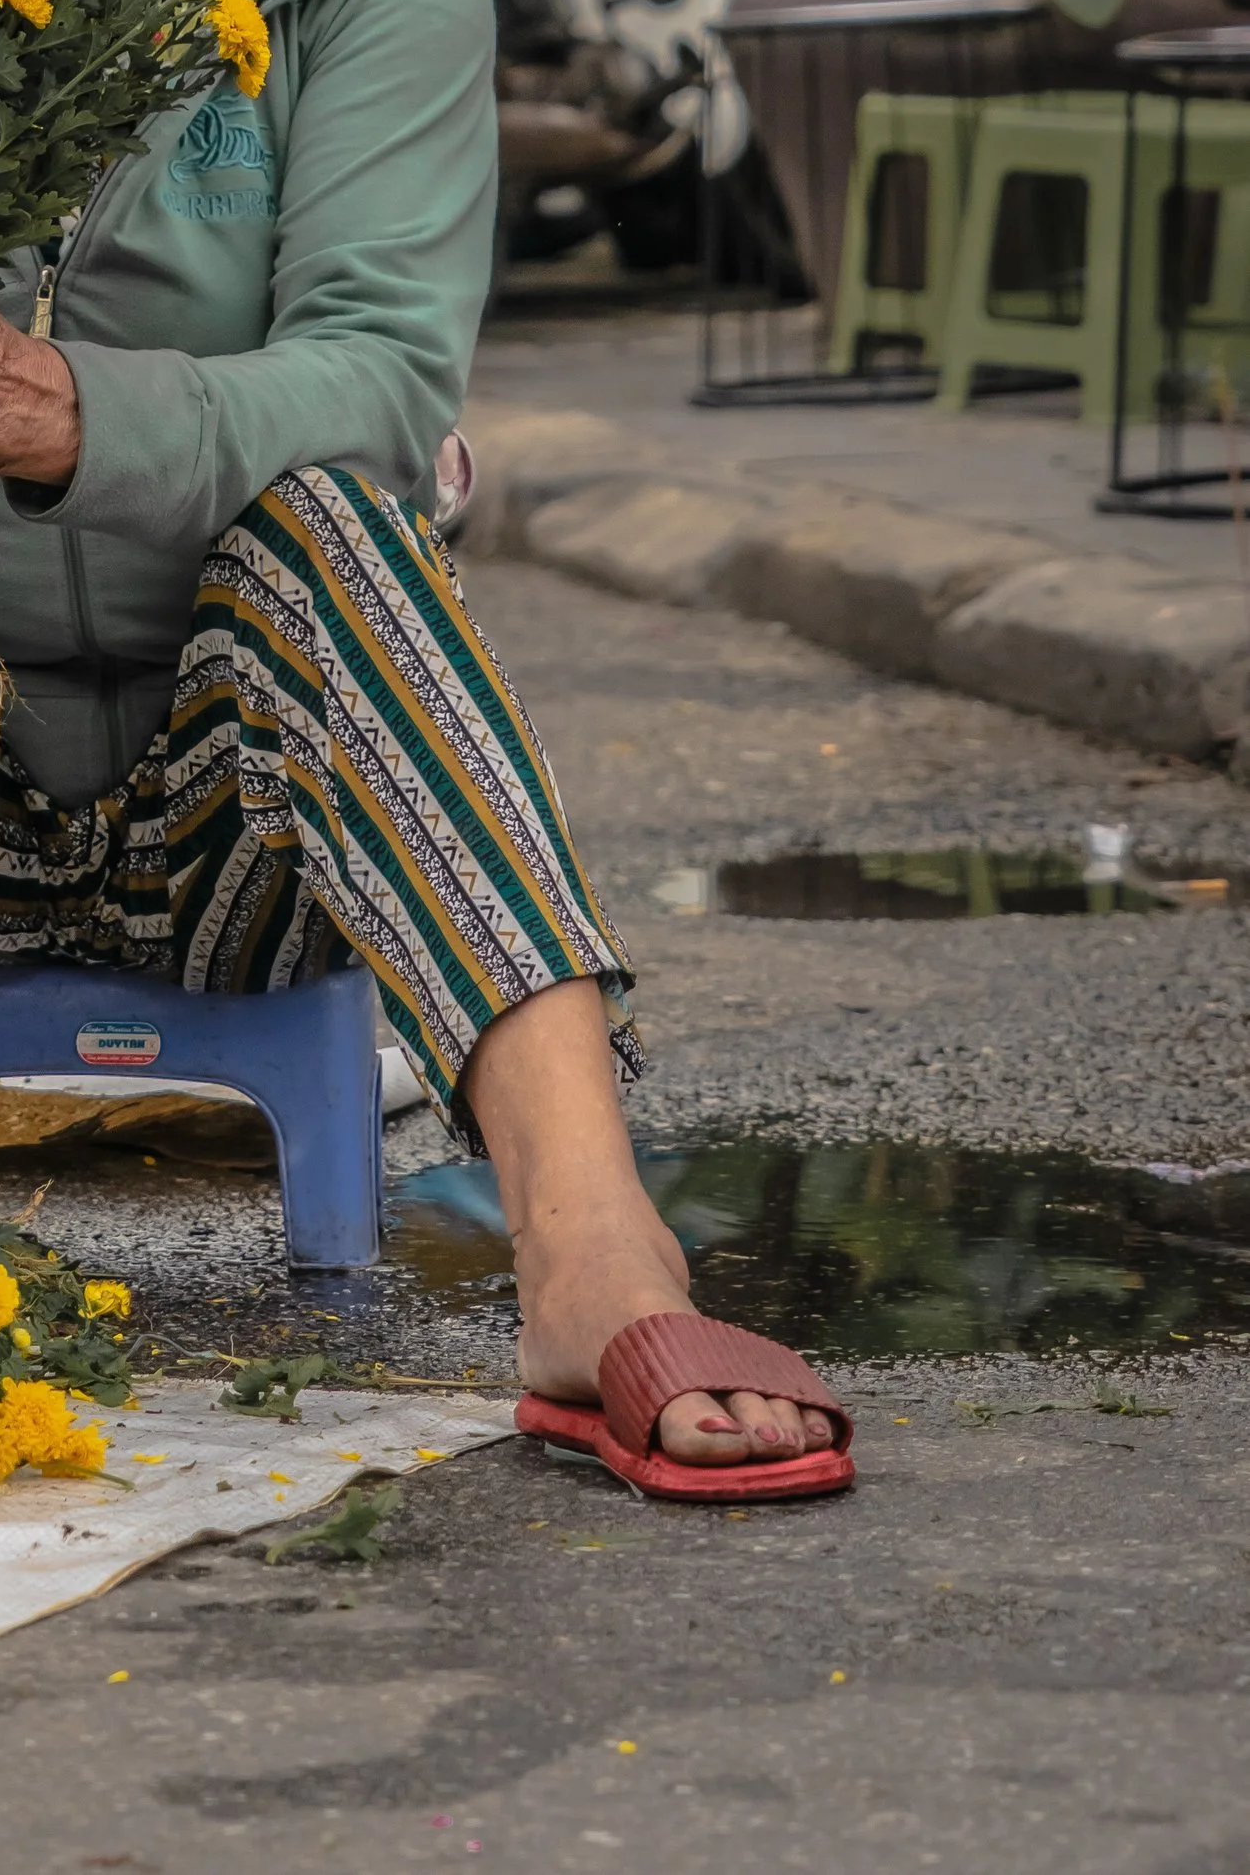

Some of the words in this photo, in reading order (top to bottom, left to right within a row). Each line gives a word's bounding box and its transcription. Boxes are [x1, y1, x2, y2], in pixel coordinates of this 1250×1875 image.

[385, 546, 470, 666] BURBERRY
[456, 658, 533, 782] BURBERRY
[369, 686, 451, 793] BURBERRY
[437, 786, 516, 892] BURBERRY
[504, 888, 572, 982] BURBER
